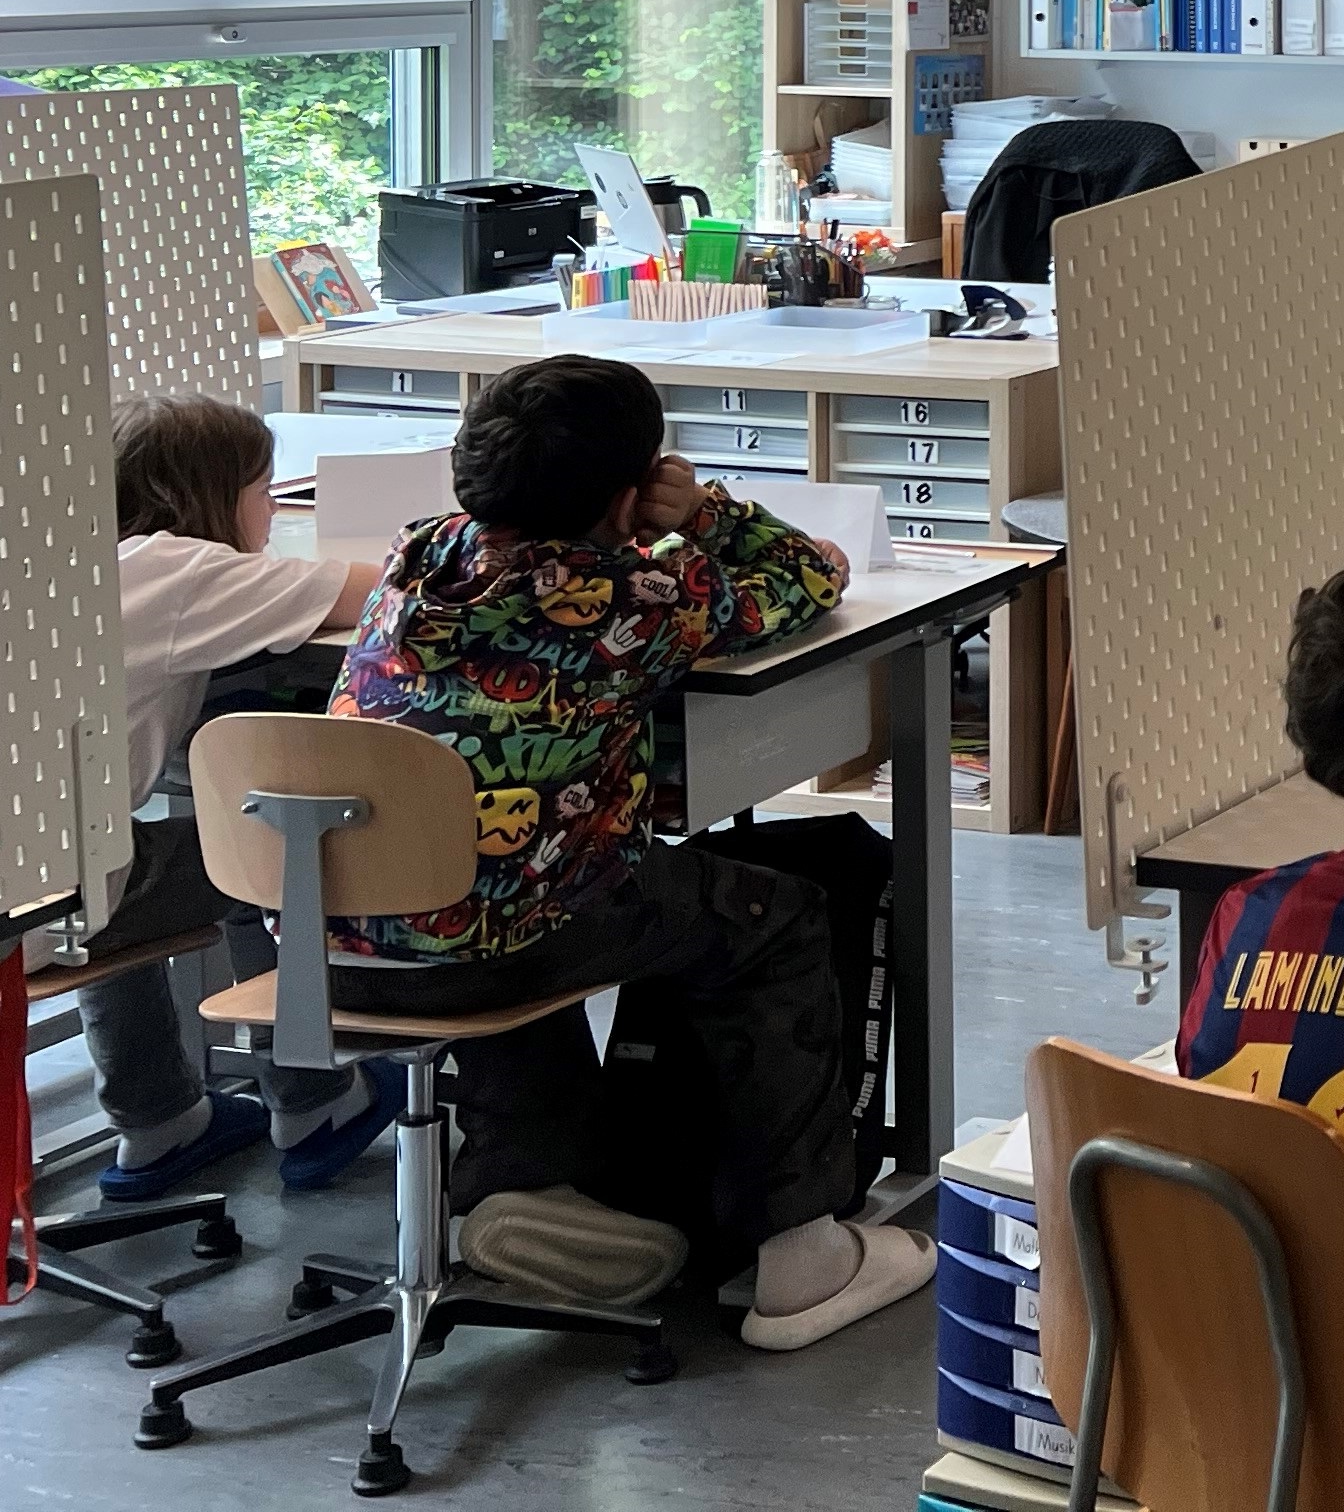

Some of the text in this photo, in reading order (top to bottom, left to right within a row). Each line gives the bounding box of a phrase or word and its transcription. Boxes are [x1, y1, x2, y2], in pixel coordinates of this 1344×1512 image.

[398, 372, 405, 392] 1
[723, 389, 745, 410] 11
[901, 402, 928, 424] 16
[737, 428, 760, 450] 12
[909, 440, 935, 463] 17
[903, 482, 933, 504] 18
[640, 576, 677, 600] COOL!
[868, 966, 885, 1010] PUMA
[866, 1020, 880, 1062] PUMA
[852, 1071, 877, 1118] PUMA
[1039, 1432, 1076, 1456] Musik
